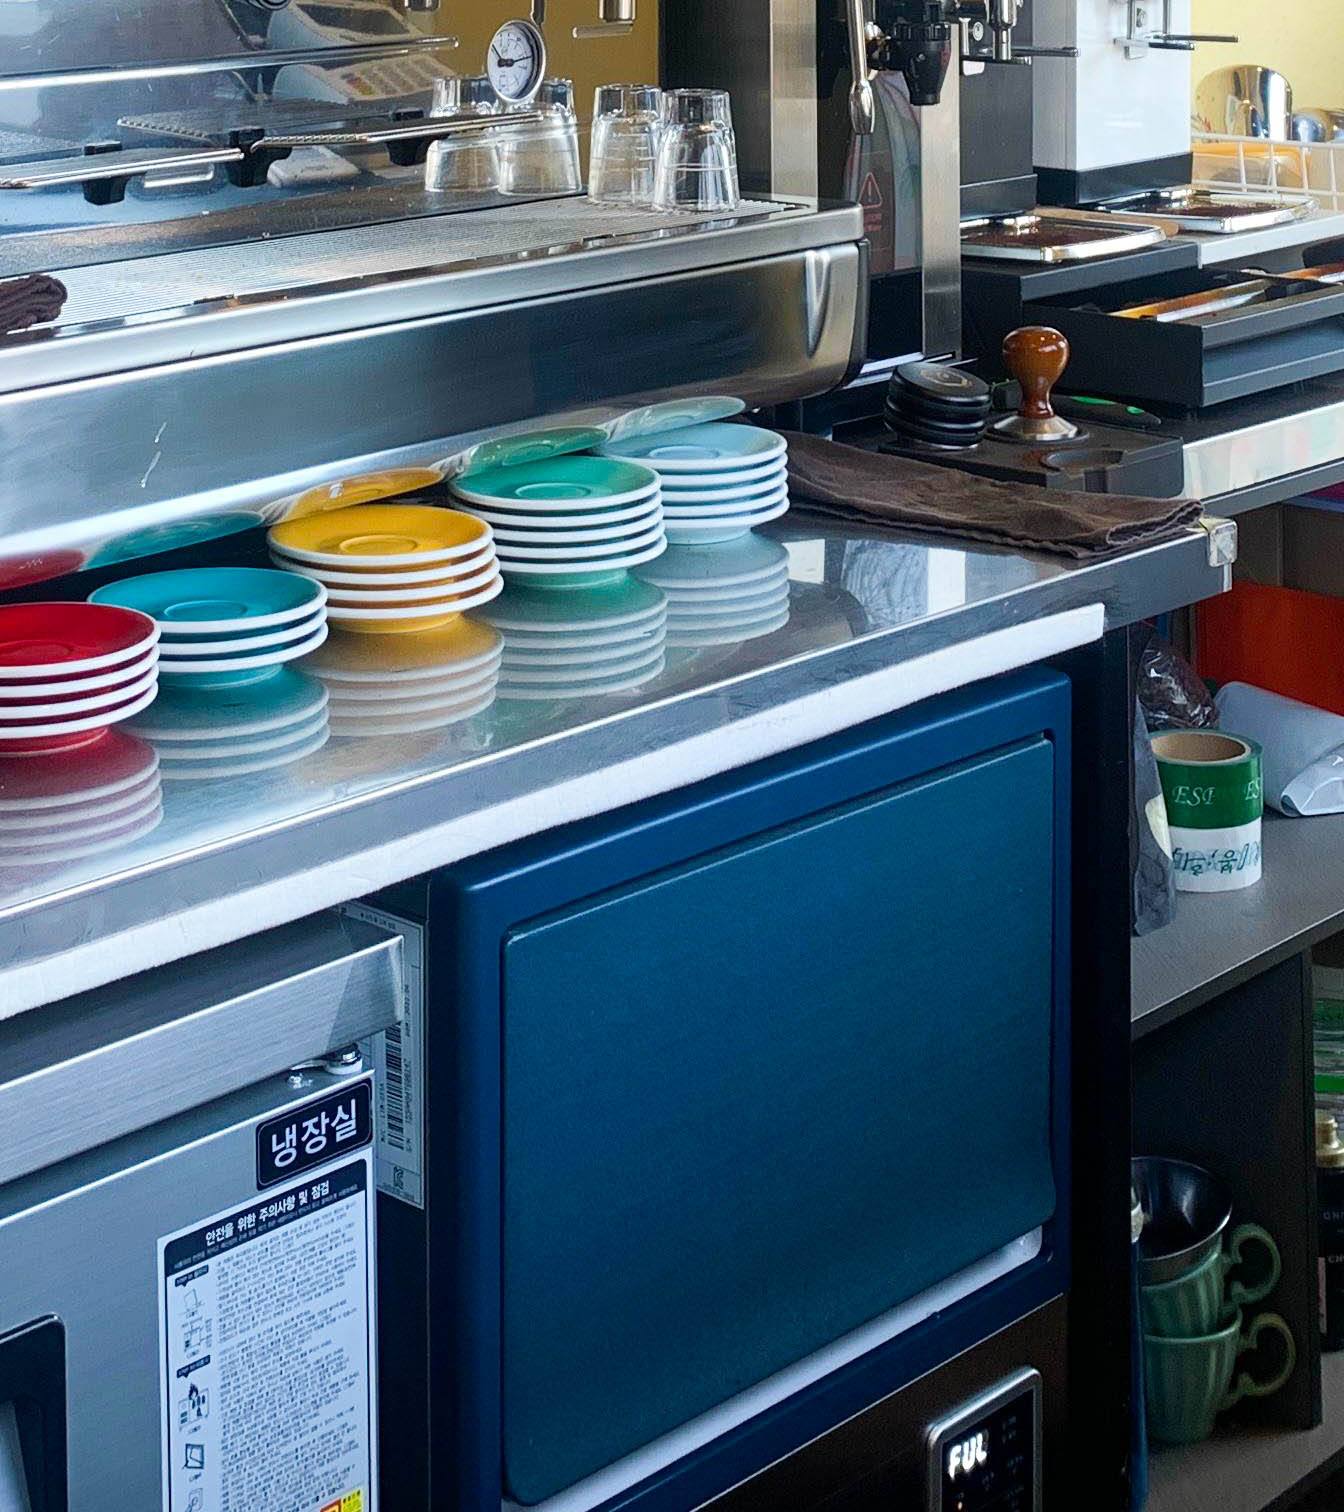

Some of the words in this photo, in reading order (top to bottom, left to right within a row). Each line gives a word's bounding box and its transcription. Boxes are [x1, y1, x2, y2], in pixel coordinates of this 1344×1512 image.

[271, 1097, 359, 1169] 냉장실
[206, 1225, 235, 1247] 안전을
[238, 1213, 256, 1232] 위한
[259, 1195, 296, 1222] 주의사항
[299, 1190, 308, 1205] 및
[312, 1181, 330, 1199] 점검
